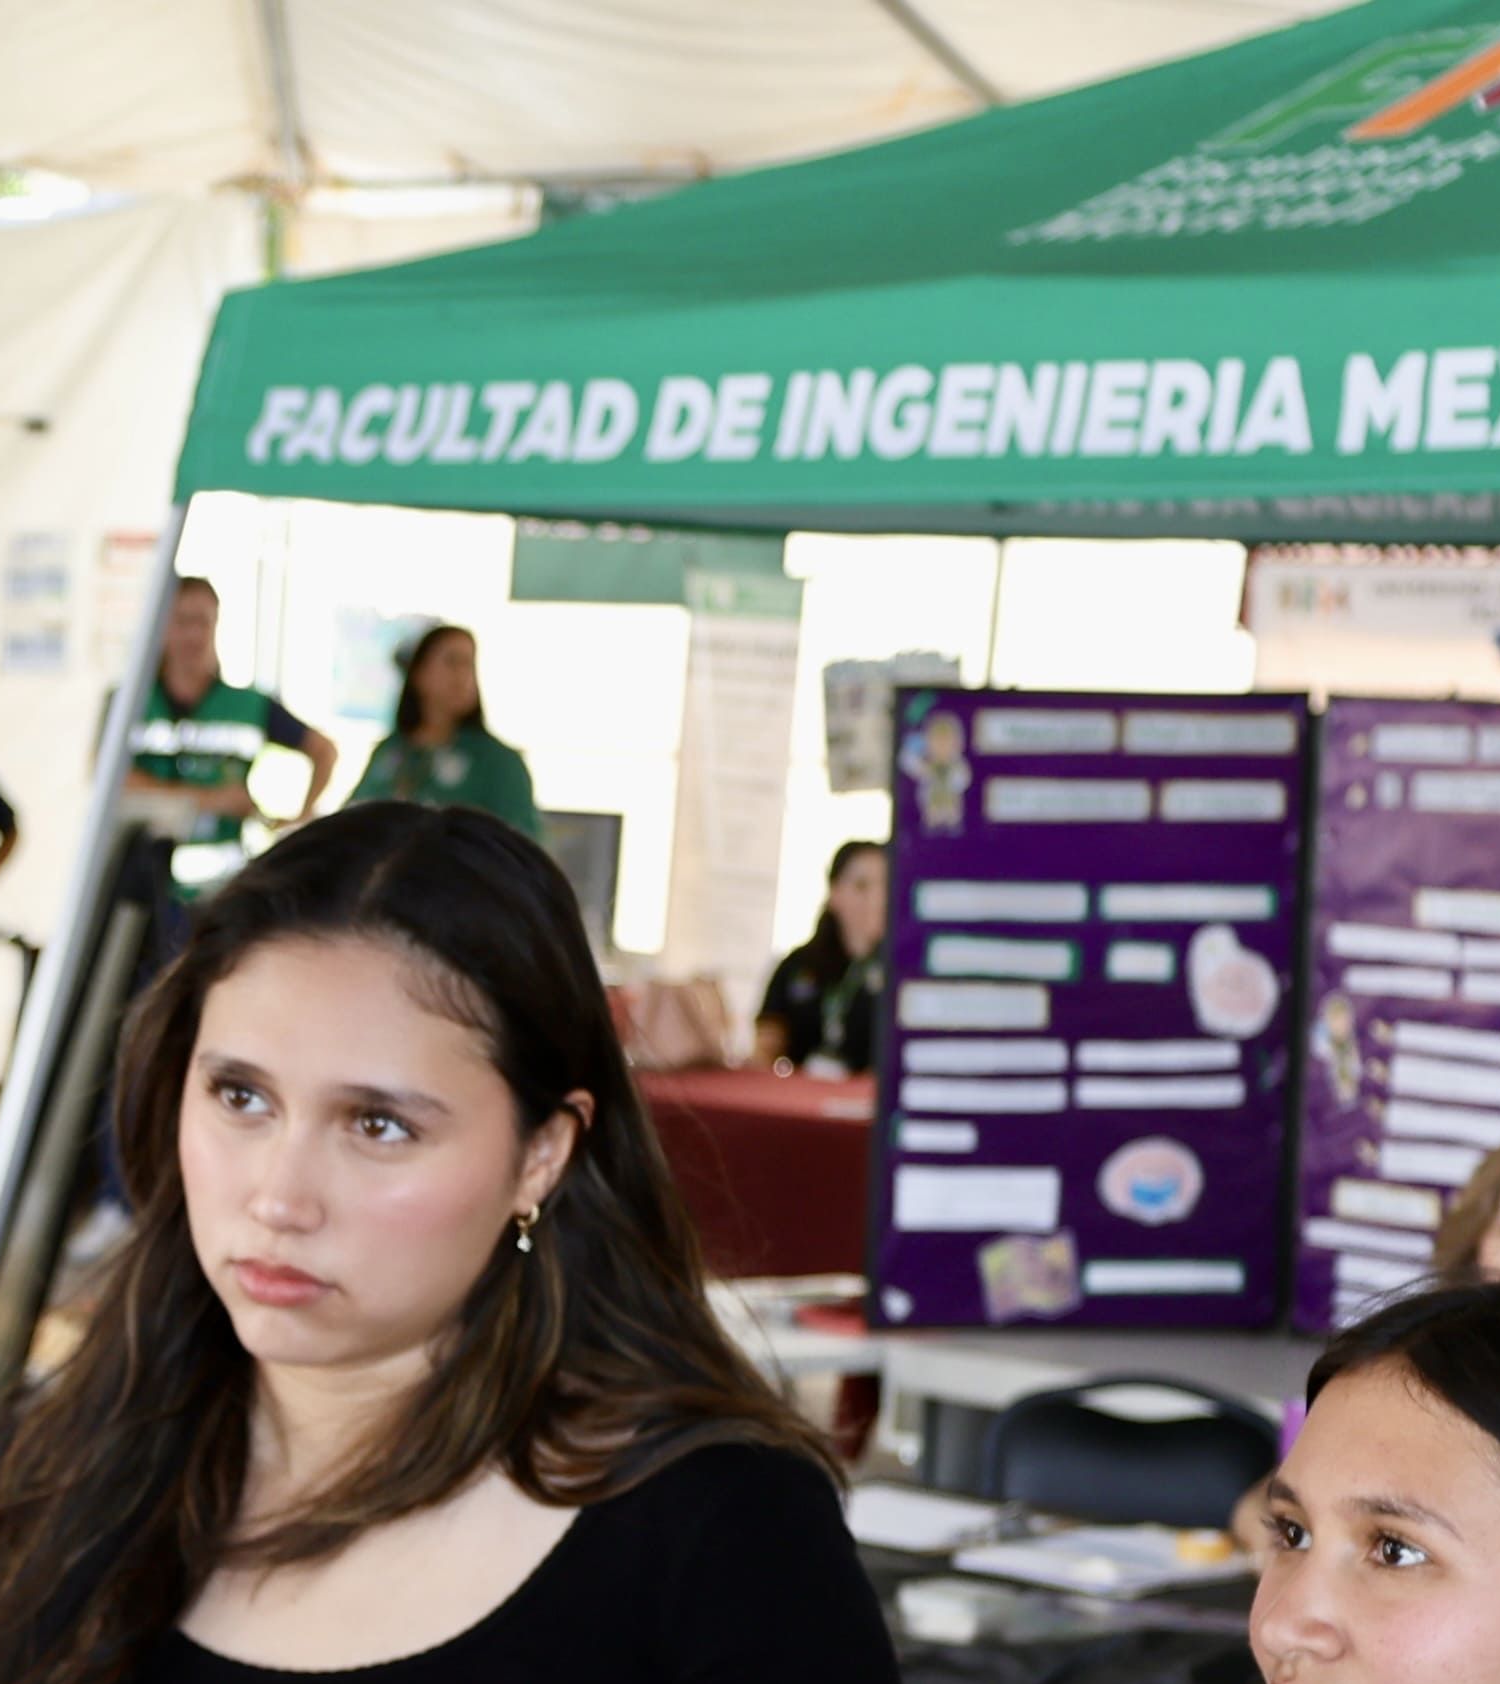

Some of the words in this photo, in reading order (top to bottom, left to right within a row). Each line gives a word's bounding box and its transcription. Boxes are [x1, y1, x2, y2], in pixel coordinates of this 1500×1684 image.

[246, 379, 638, 466] FACULTAD
[644, 373, 775, 463] DE
[774, 356, 1312, 463] INGENIERIA
